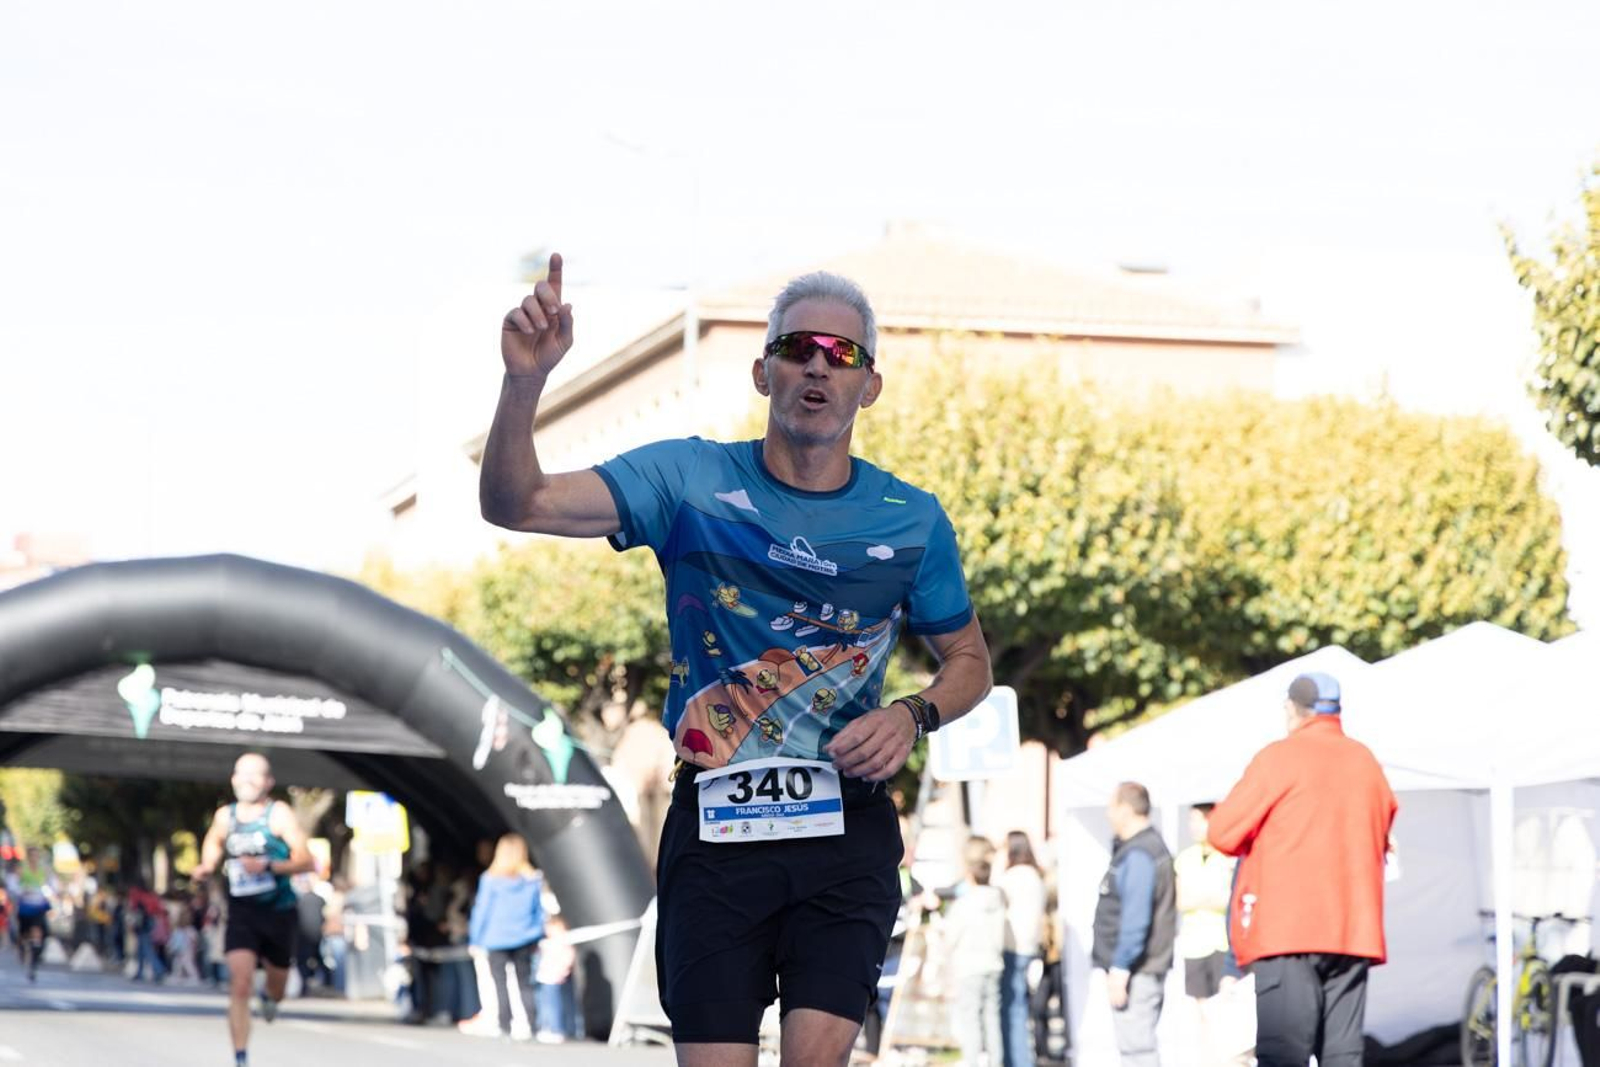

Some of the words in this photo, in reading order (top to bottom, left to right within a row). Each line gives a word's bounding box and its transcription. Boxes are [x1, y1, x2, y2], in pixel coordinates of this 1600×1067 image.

[770, 551, 796, 564] CIUDAD
[948, 700, 1000, 770] P
[727, 767, 813, 804] 340
[735, 805, 781, 815] FRANCISCO
